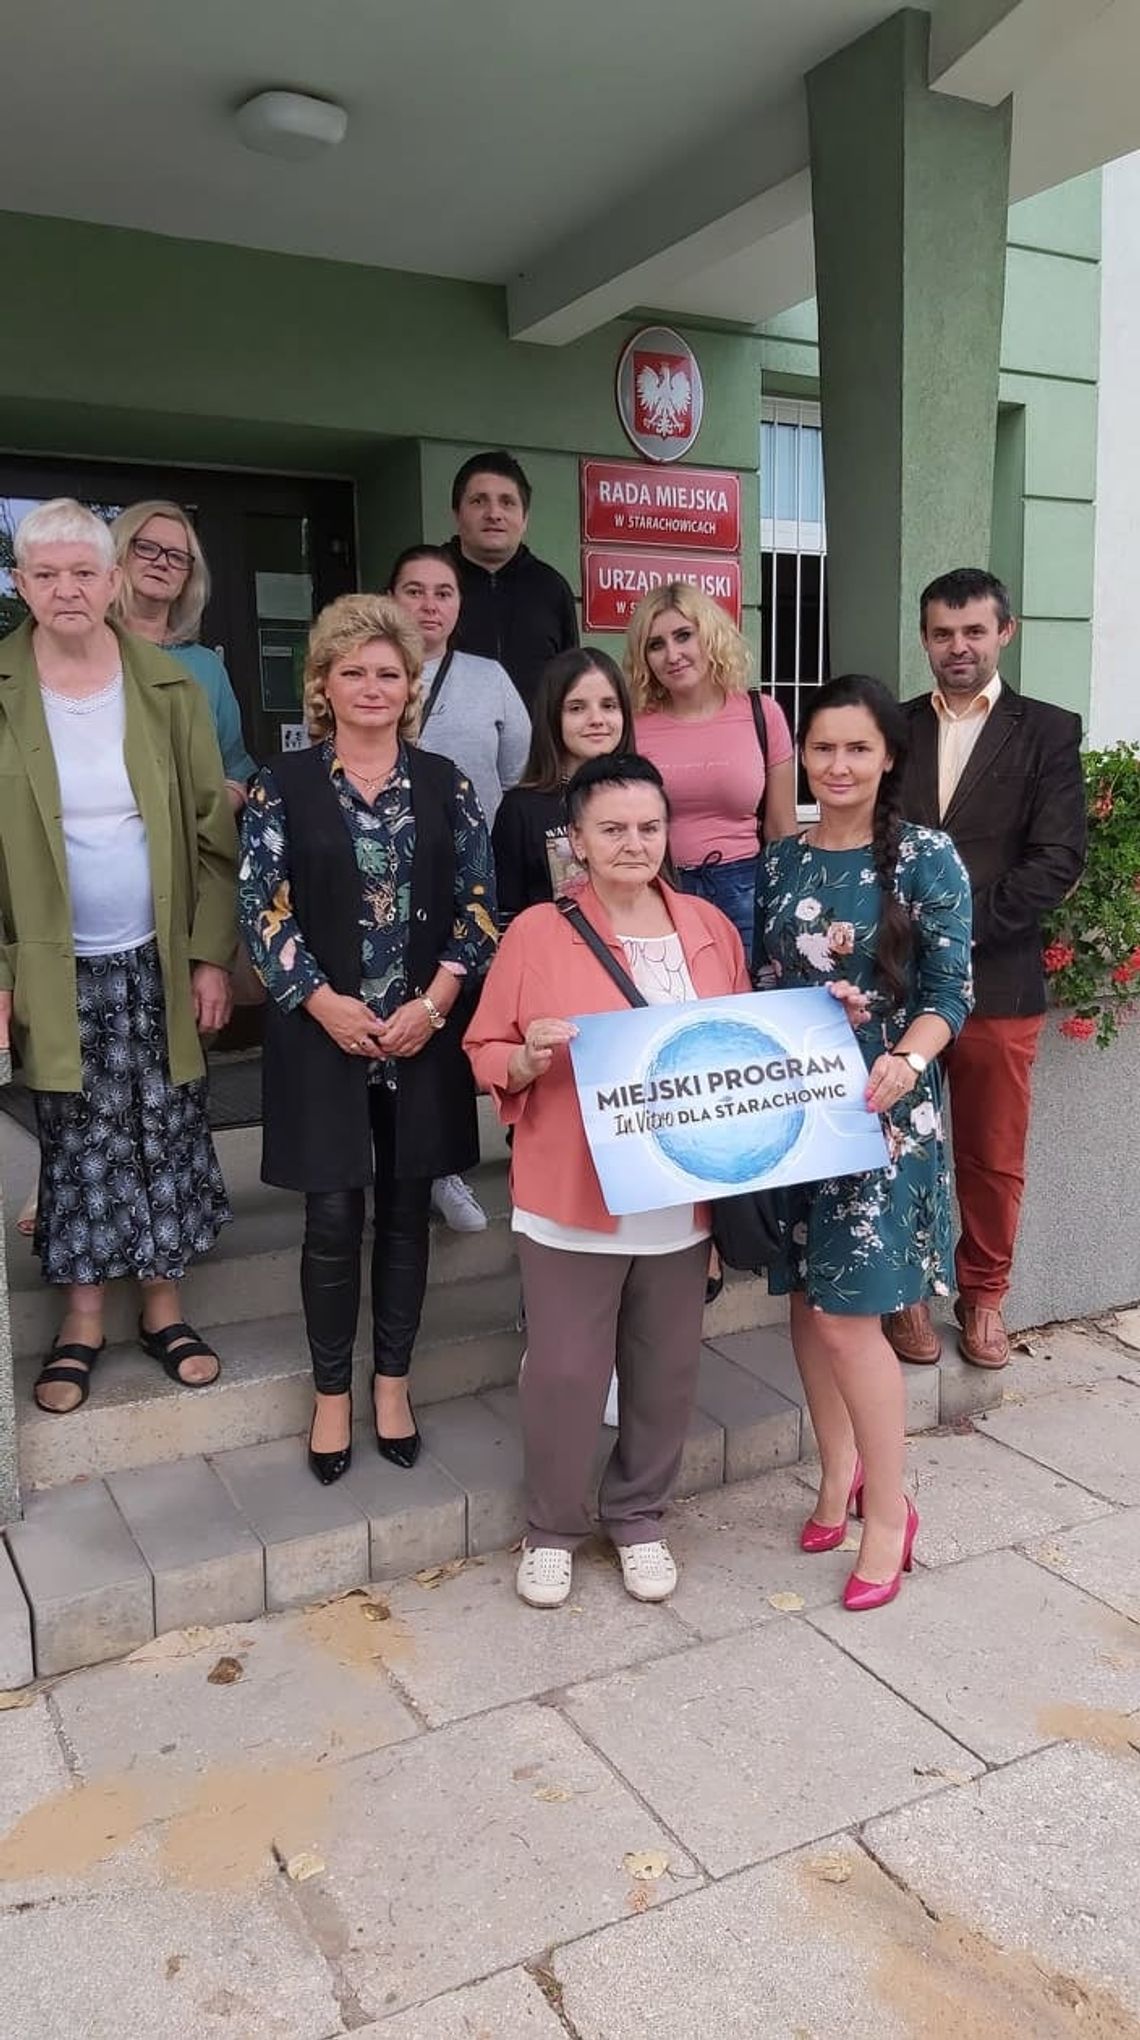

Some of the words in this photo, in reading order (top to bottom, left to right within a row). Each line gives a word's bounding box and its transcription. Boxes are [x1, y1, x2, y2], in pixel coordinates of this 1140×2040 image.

[599, 480, 652, 507] RADA
[656, 485, 729, 513] MIEJSKA
[614, 513, 625, 528] W
[628, 516, 717, 535] STARACHOWICACH
[599, 567, 662, 596] URZĄD
[616, 601, 626, 615] W
[596, 1075, 702, 1111] MIEJSKI
[707, 1055, 846, 1094] PROGRAM
[614, 1114, 636, 1136] In
[635, 1109, 674, 1133] Vitro
[677, 1108, 712, 1124] DLA
[714, 1084, 848, 1119] STARACHOWIC
